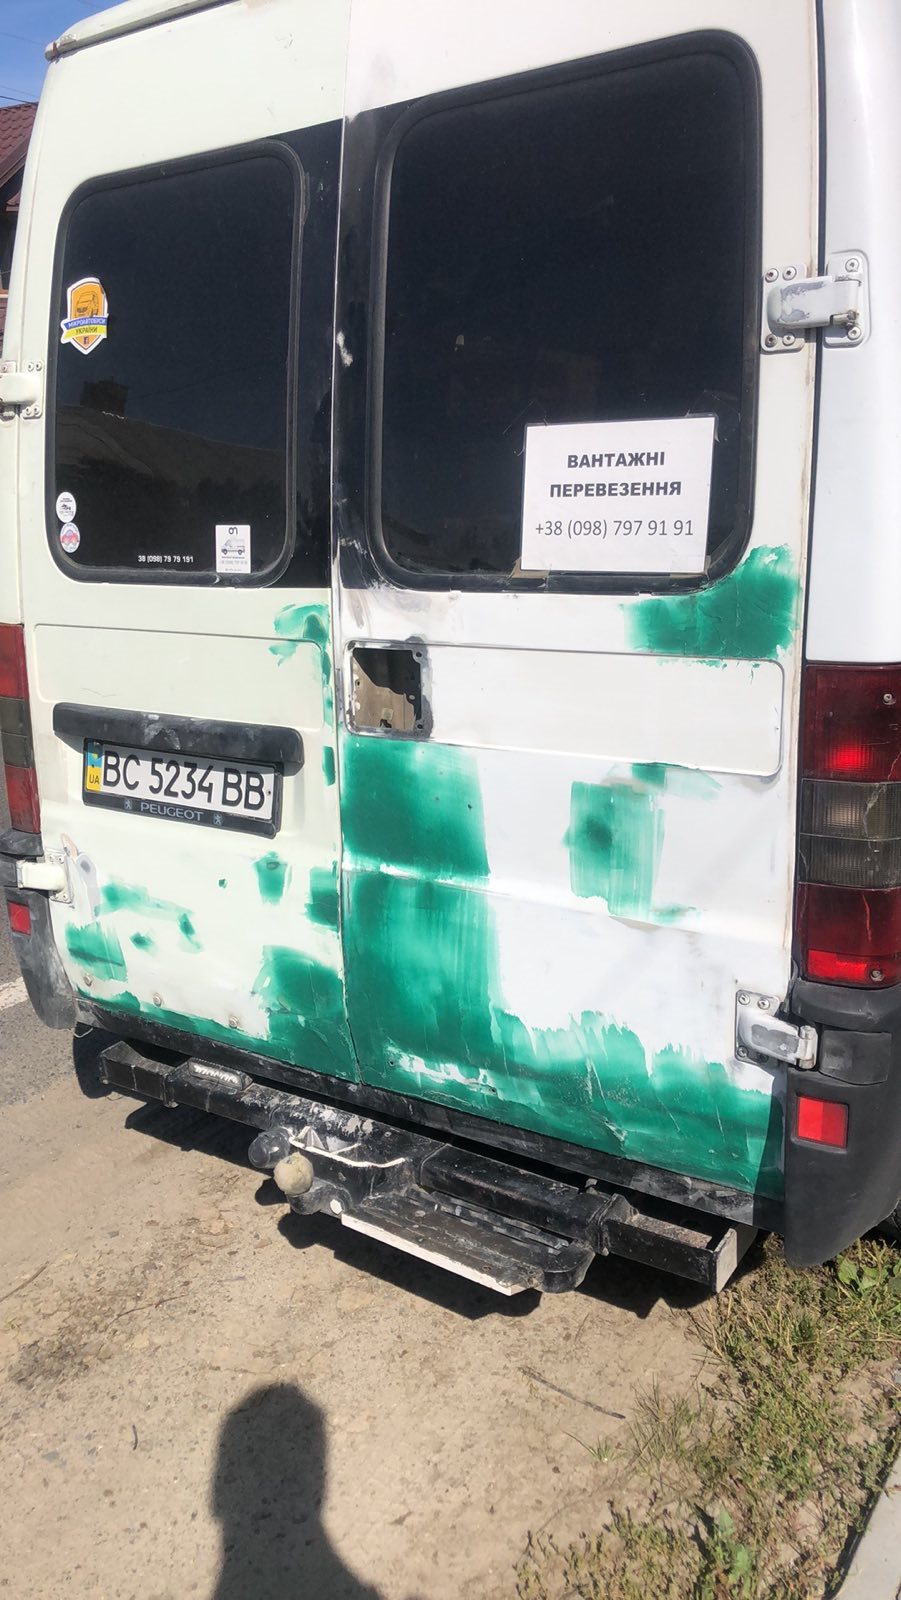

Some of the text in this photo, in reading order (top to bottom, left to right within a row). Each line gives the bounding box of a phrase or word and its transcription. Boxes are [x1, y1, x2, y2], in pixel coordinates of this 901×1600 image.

[75, 326, 98, 335] УКРАЇНИ
[567, 451, 665, 468] ВАНТАЖНІ
[550, 481, 682, 498] ПЕРЕВЕЗЕННЯ
[535, 519, 694, 539] +38 (098) 797 91 91
[182, 555, 194, 563] 191
[89, 774, 100, 785] UA
[149, 757, 214, 803] 5234
[140, 802, 204, 821] PEUGEOT
